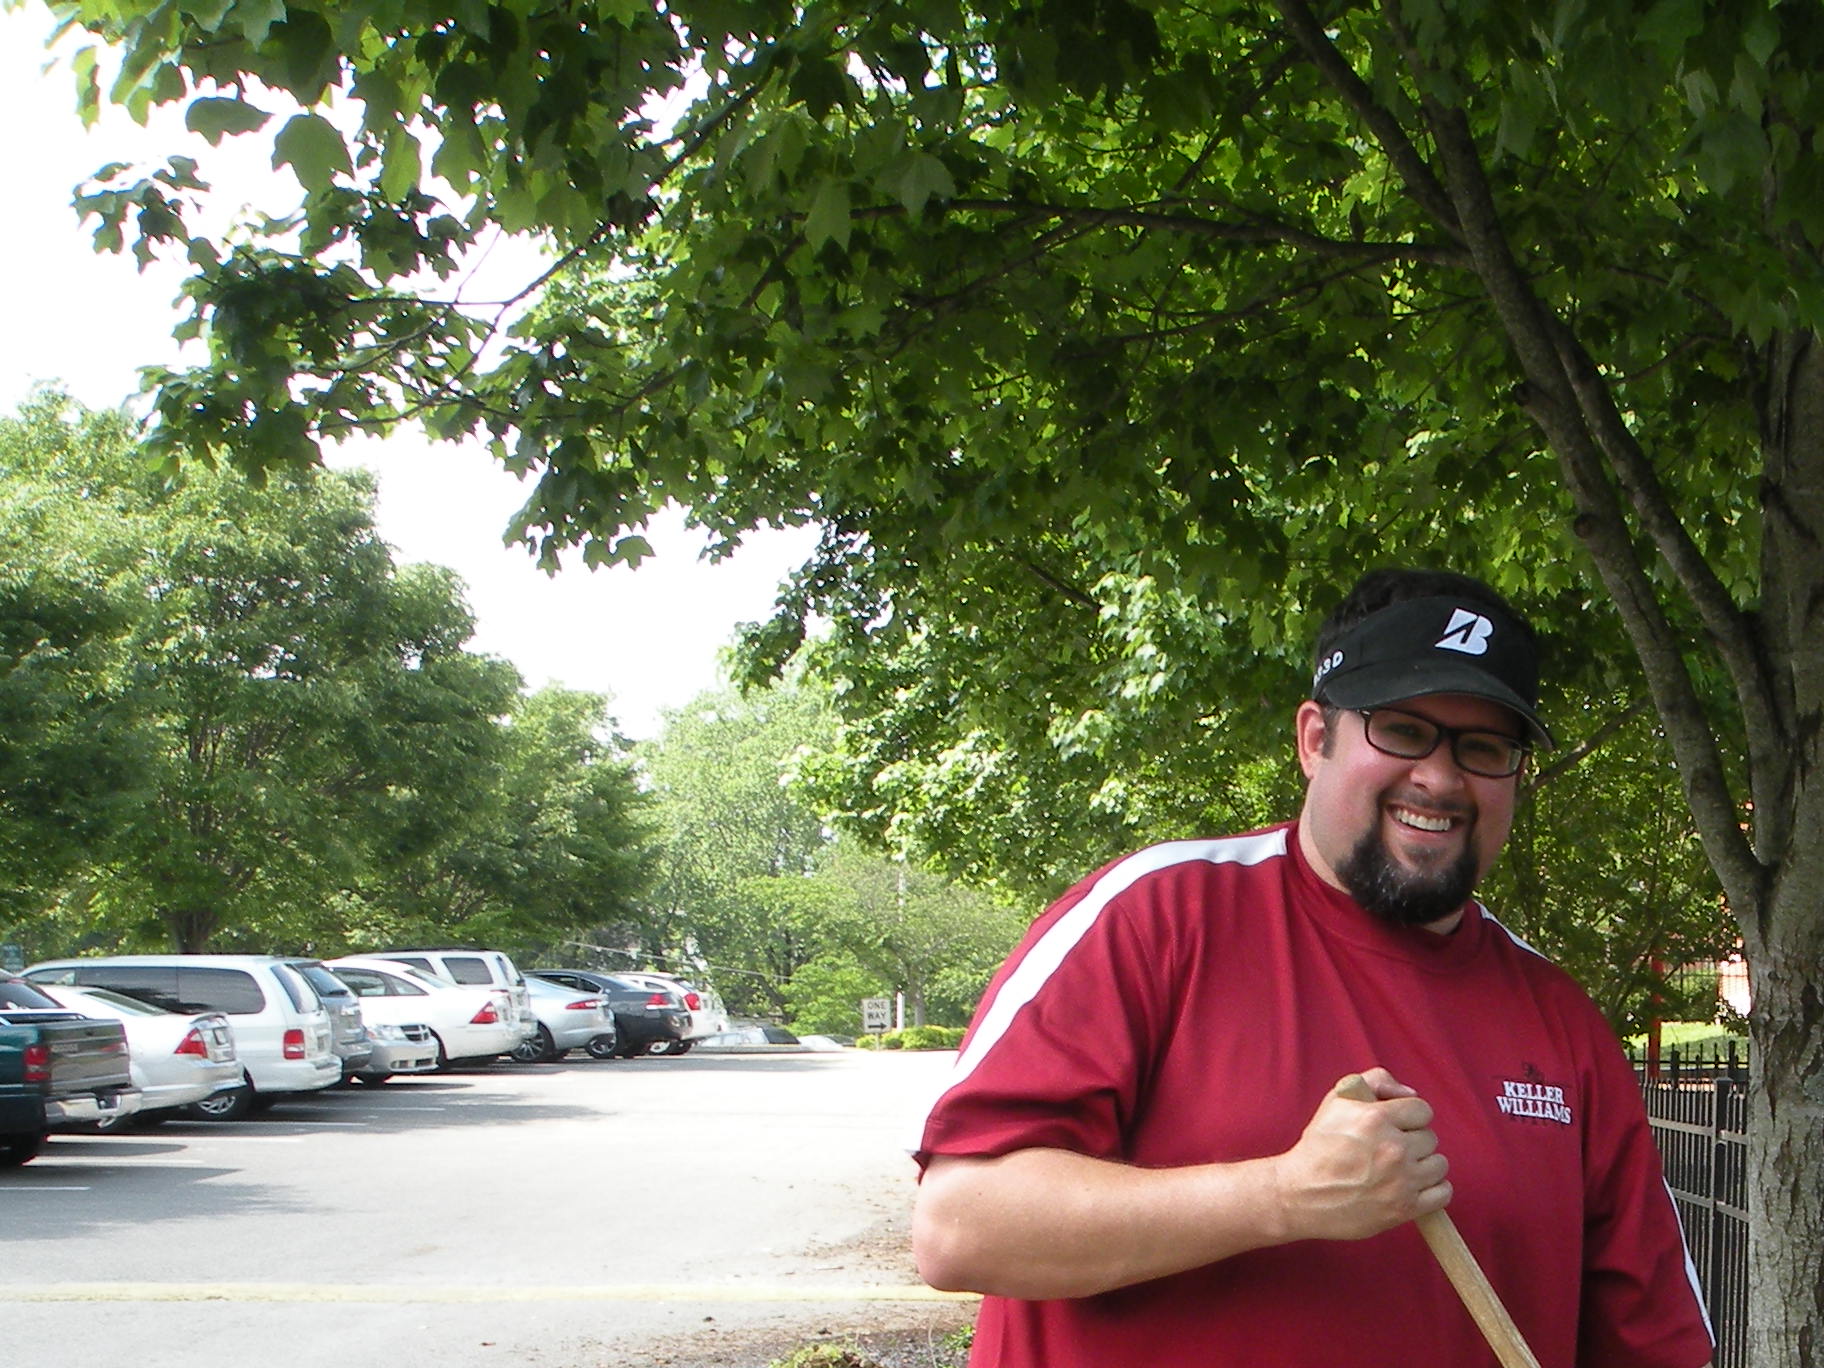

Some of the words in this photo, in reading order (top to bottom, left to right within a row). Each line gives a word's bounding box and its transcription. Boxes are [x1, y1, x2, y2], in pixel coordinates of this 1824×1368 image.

[867, 1001, 887, 1010] ONE
[867, 1011, 887, 1020] WAY
[1503, 1080, 1565, 1105] KELLER
[1496, 1095, 1572, 1125] WILLIAMS
